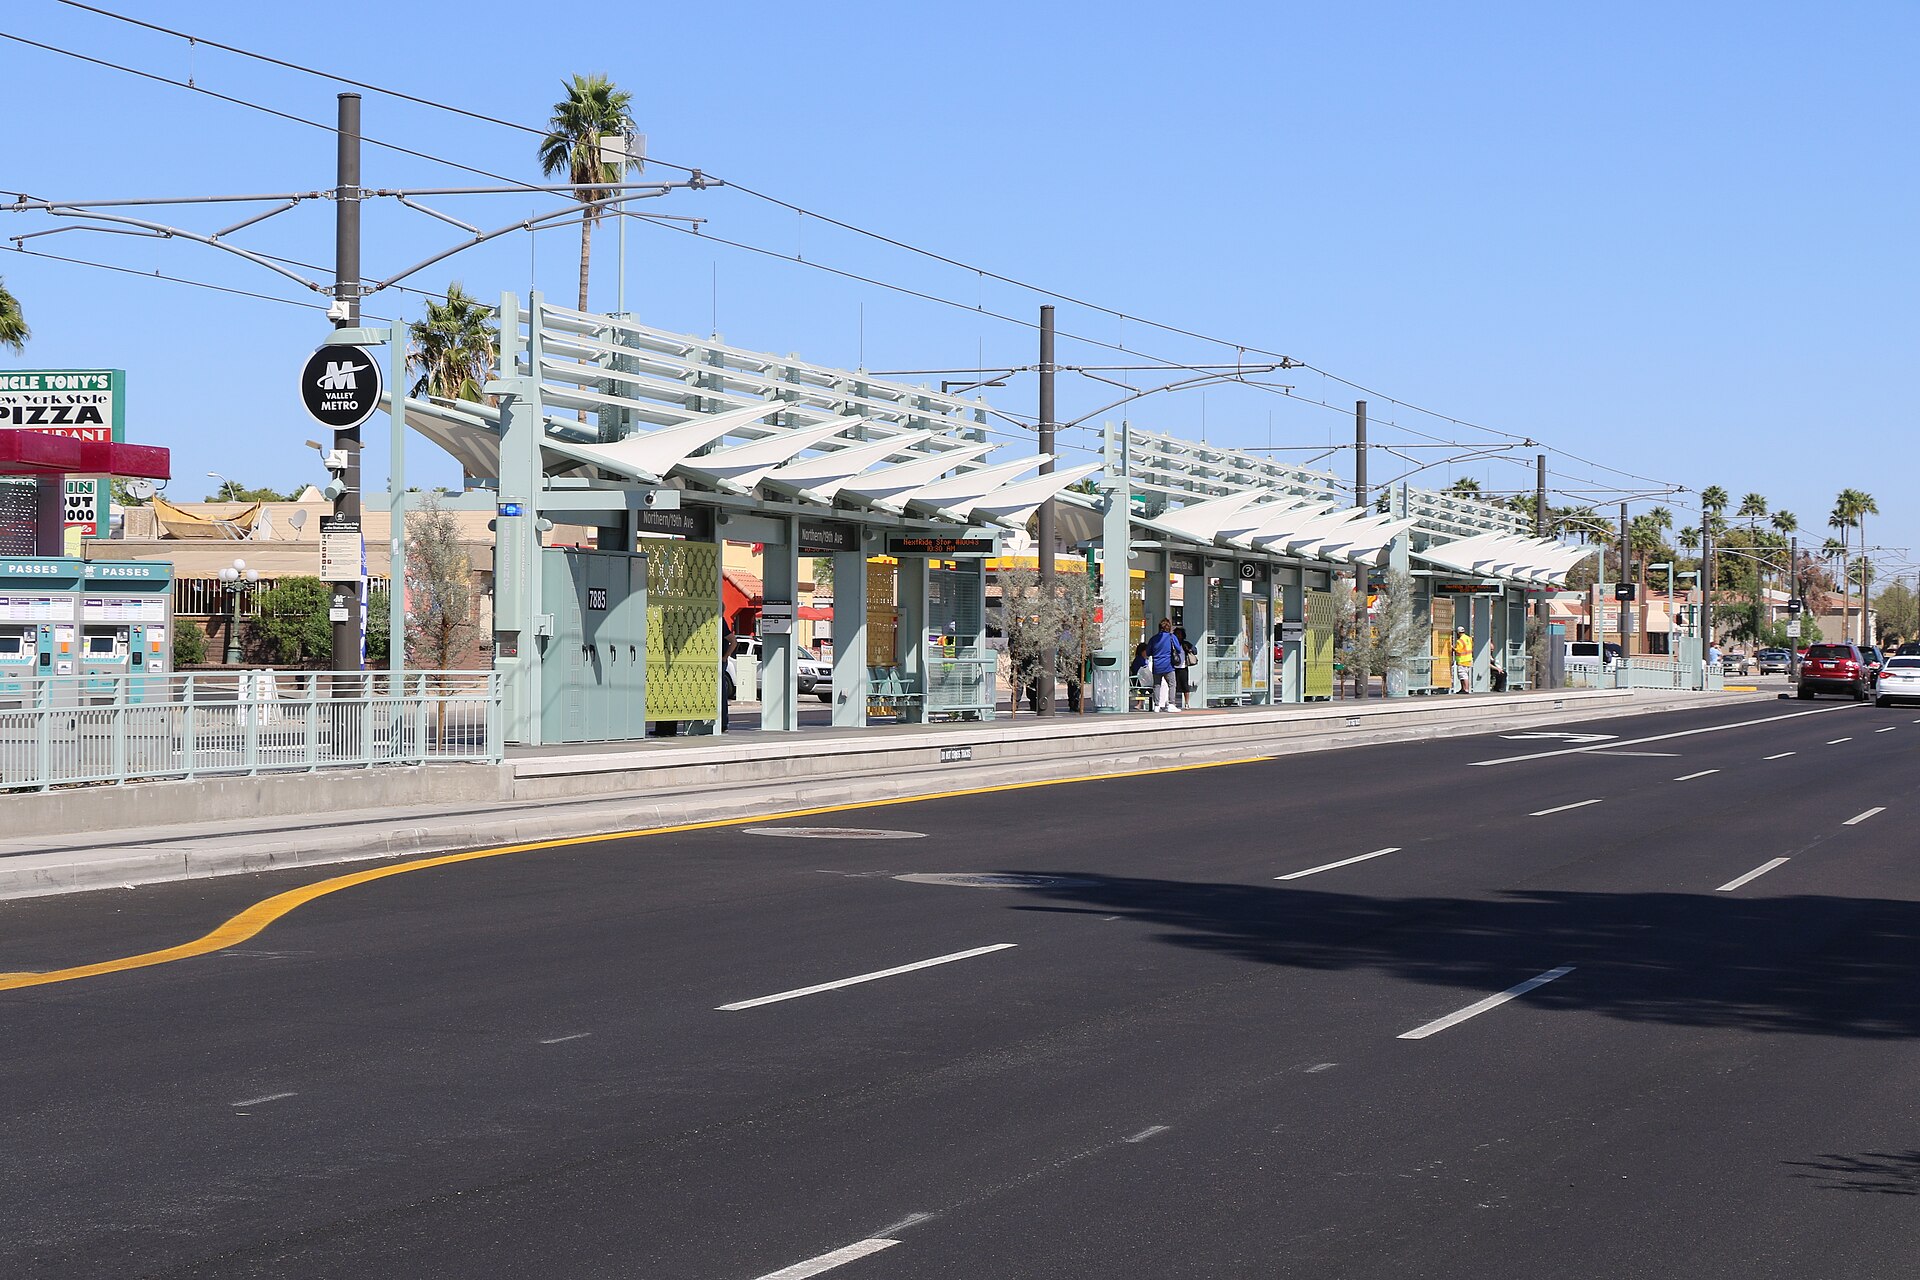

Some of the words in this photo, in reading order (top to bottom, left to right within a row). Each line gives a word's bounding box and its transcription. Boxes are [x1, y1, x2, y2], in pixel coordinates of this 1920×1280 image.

[45, 375, 108, 389] TONY'S
[23, 395, 62, 404] York
[66, 394, 107, 405] Style
[325, 392, 354, 400] VALLEY
[321, 400, 358, 410] METRO
[66, 481, 94, 494] IN
[64, 497, 93, 507] UT
[643, 511, 682, 527] Northern/19th
[683, 515, 694, 529] Ave
[8, 564, 58, 574] PASSES
[102, 568, 150, 577] PASSES
[589, 590, 606, 609] 7885
